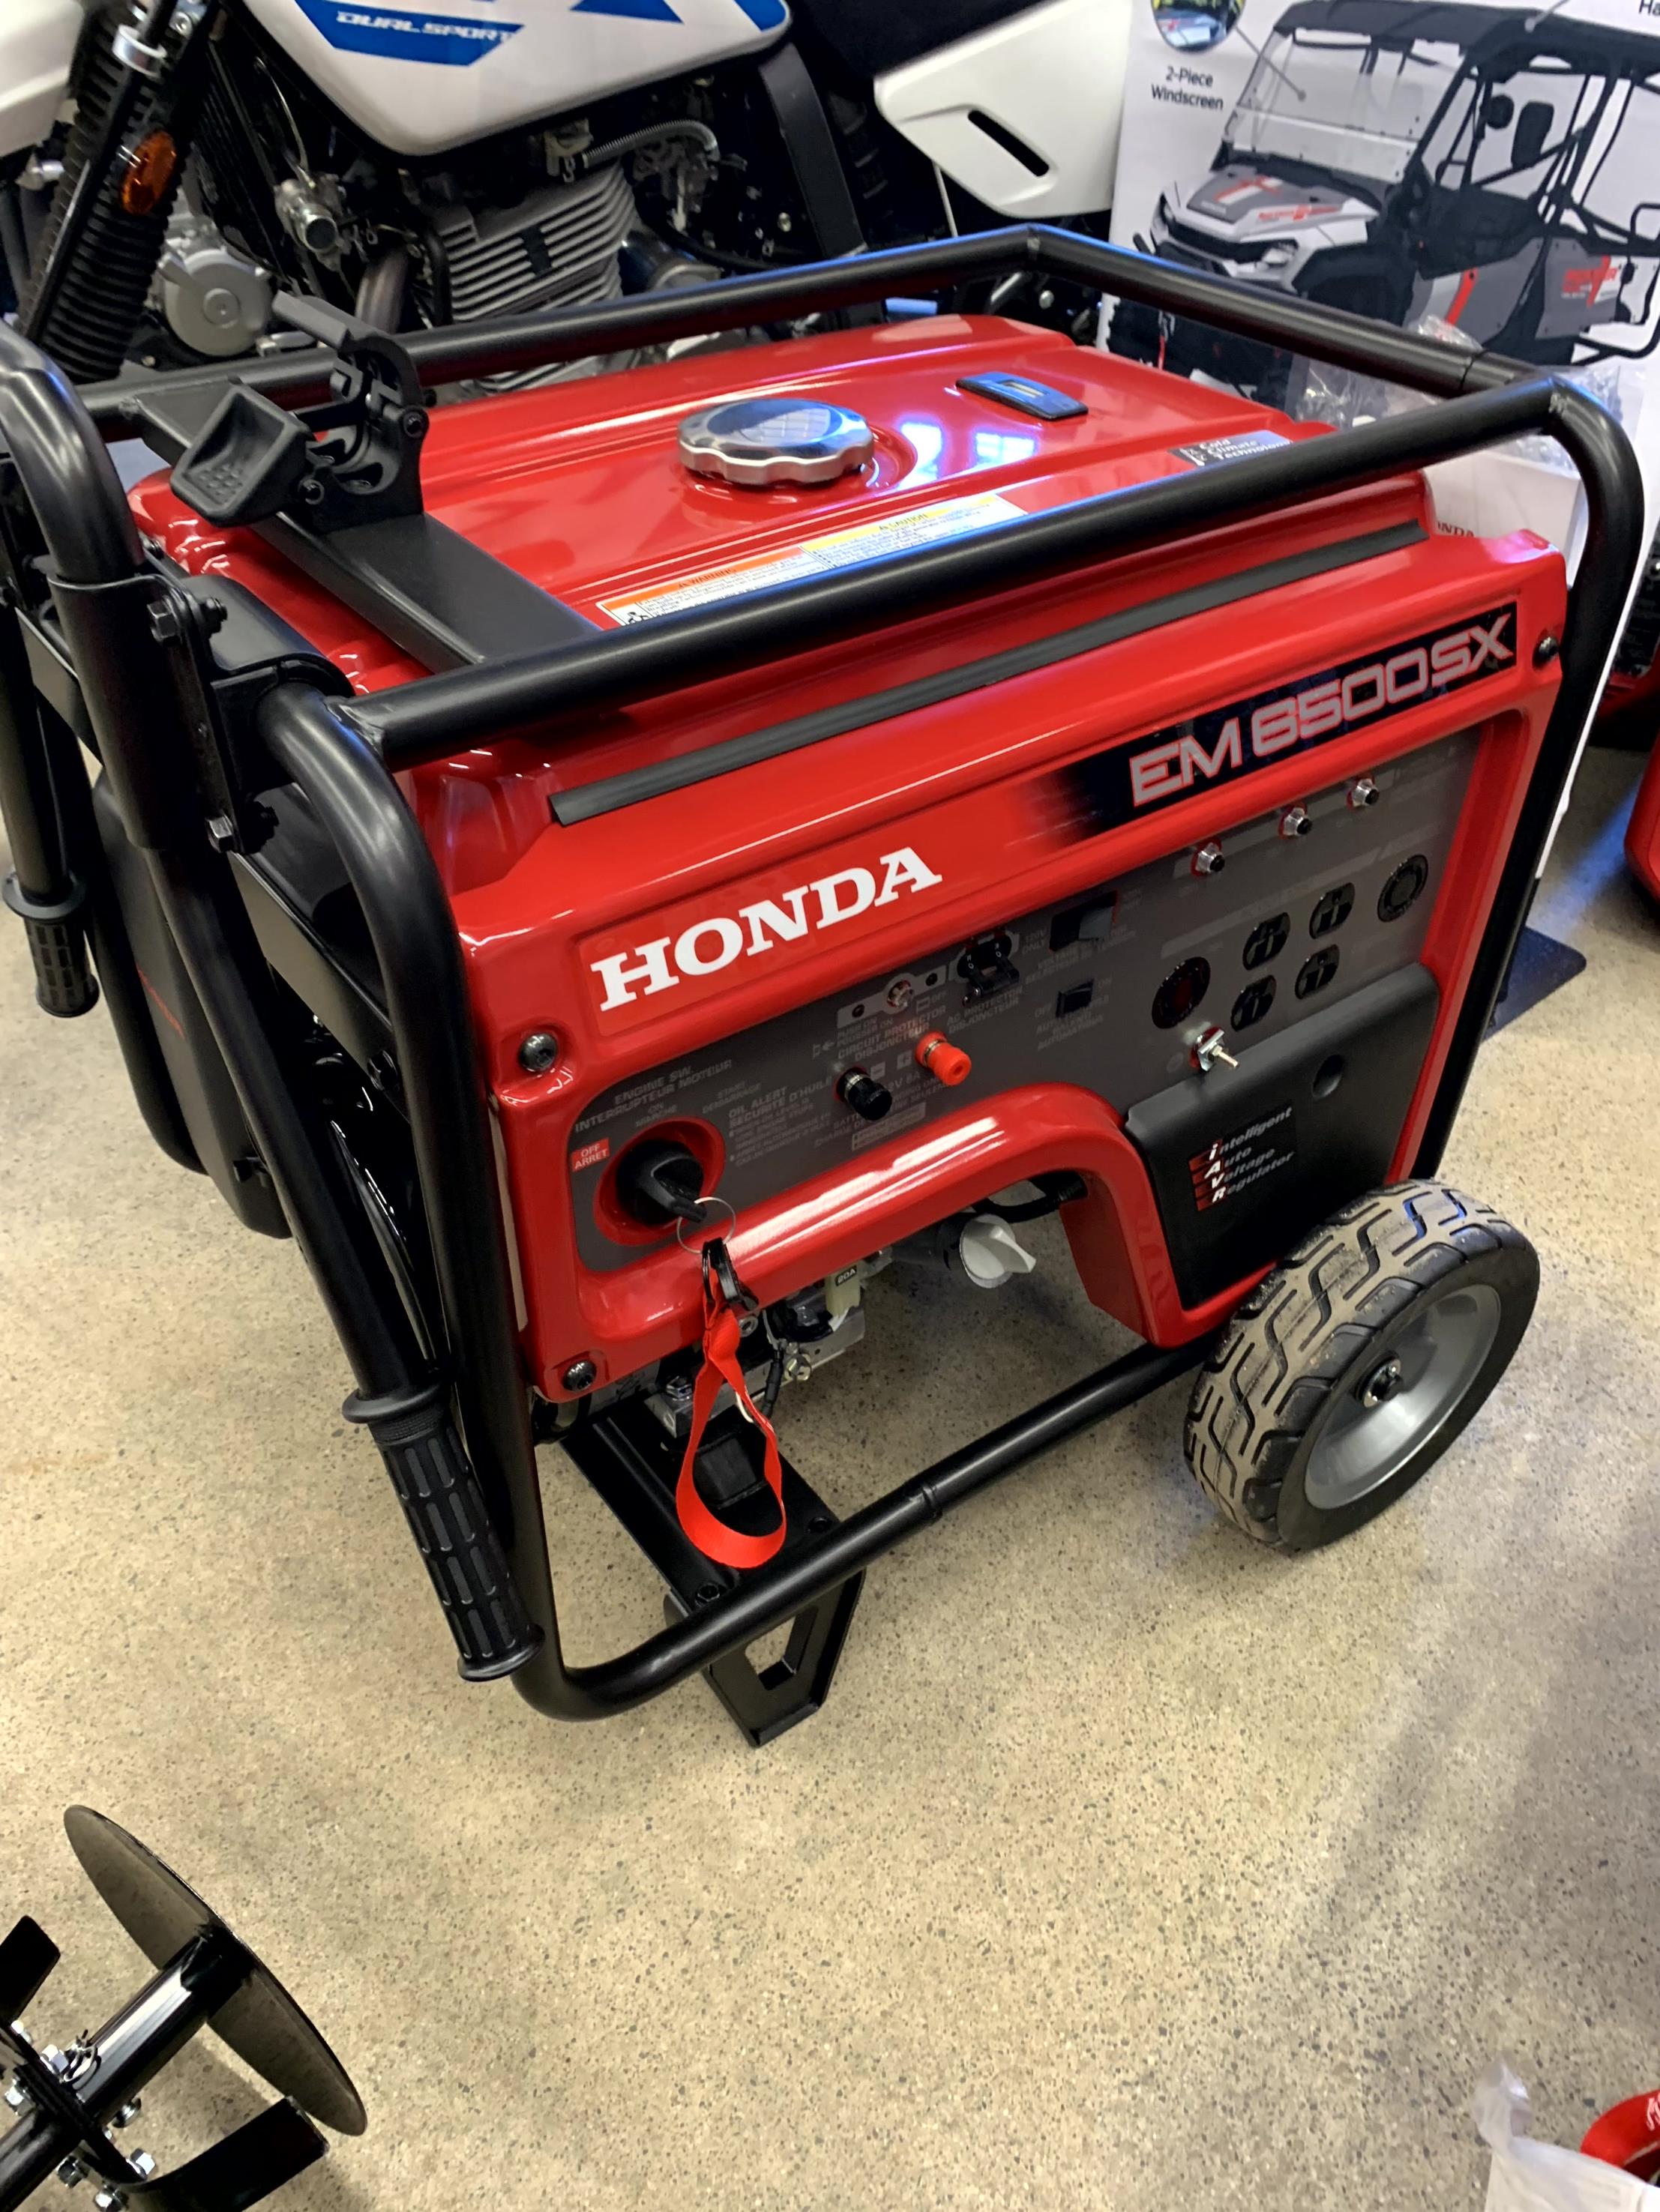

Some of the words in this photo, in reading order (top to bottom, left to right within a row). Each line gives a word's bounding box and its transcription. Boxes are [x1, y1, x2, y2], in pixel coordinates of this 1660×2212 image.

[337, 10, 421, 33] DUAL
[422, 22, 515, 41] SPORT
[1166, 65, 1213, 87] 2-Piece
[1152, 84, 1224, 110] Windscreen
[1200, 439, 1231, 450] Cold
[1207, 441, 1258, 455] Climate
[1130, 717, 1241, 807] EM
[1251, 612, 1515, 758] 6500SX
[591, 846, 942, 1011] HONDA
[837, 1034, 881, 1059] CIRCUIT
[884, 1005, 947, 1039] PROTECTOR
[855, 1022, 930, 1061] DISJONCTEUR
[575, 1083, 676, 1133] INTERRUPTEUR
[678, 1059, 733, 1089] MOTEUR
[615, 1077, 665, 1104] ENGINE
[670, 1066, 694, 1082] SW.
[729, 1106, 747, 1118] OIL
[751, 1086, 787, 1108] ALERT
[580, 1143, 601, 1157] OFF
[1209, 1106, 1292, 1161] intelligent
[574, 1151, 608, 1170] ARRET
[1204, 1147, 1251, 1179] Auto
[1212, 1148, 1275, 1189] Voltage
[1212, 1151, 1295, 1204] Regulator
